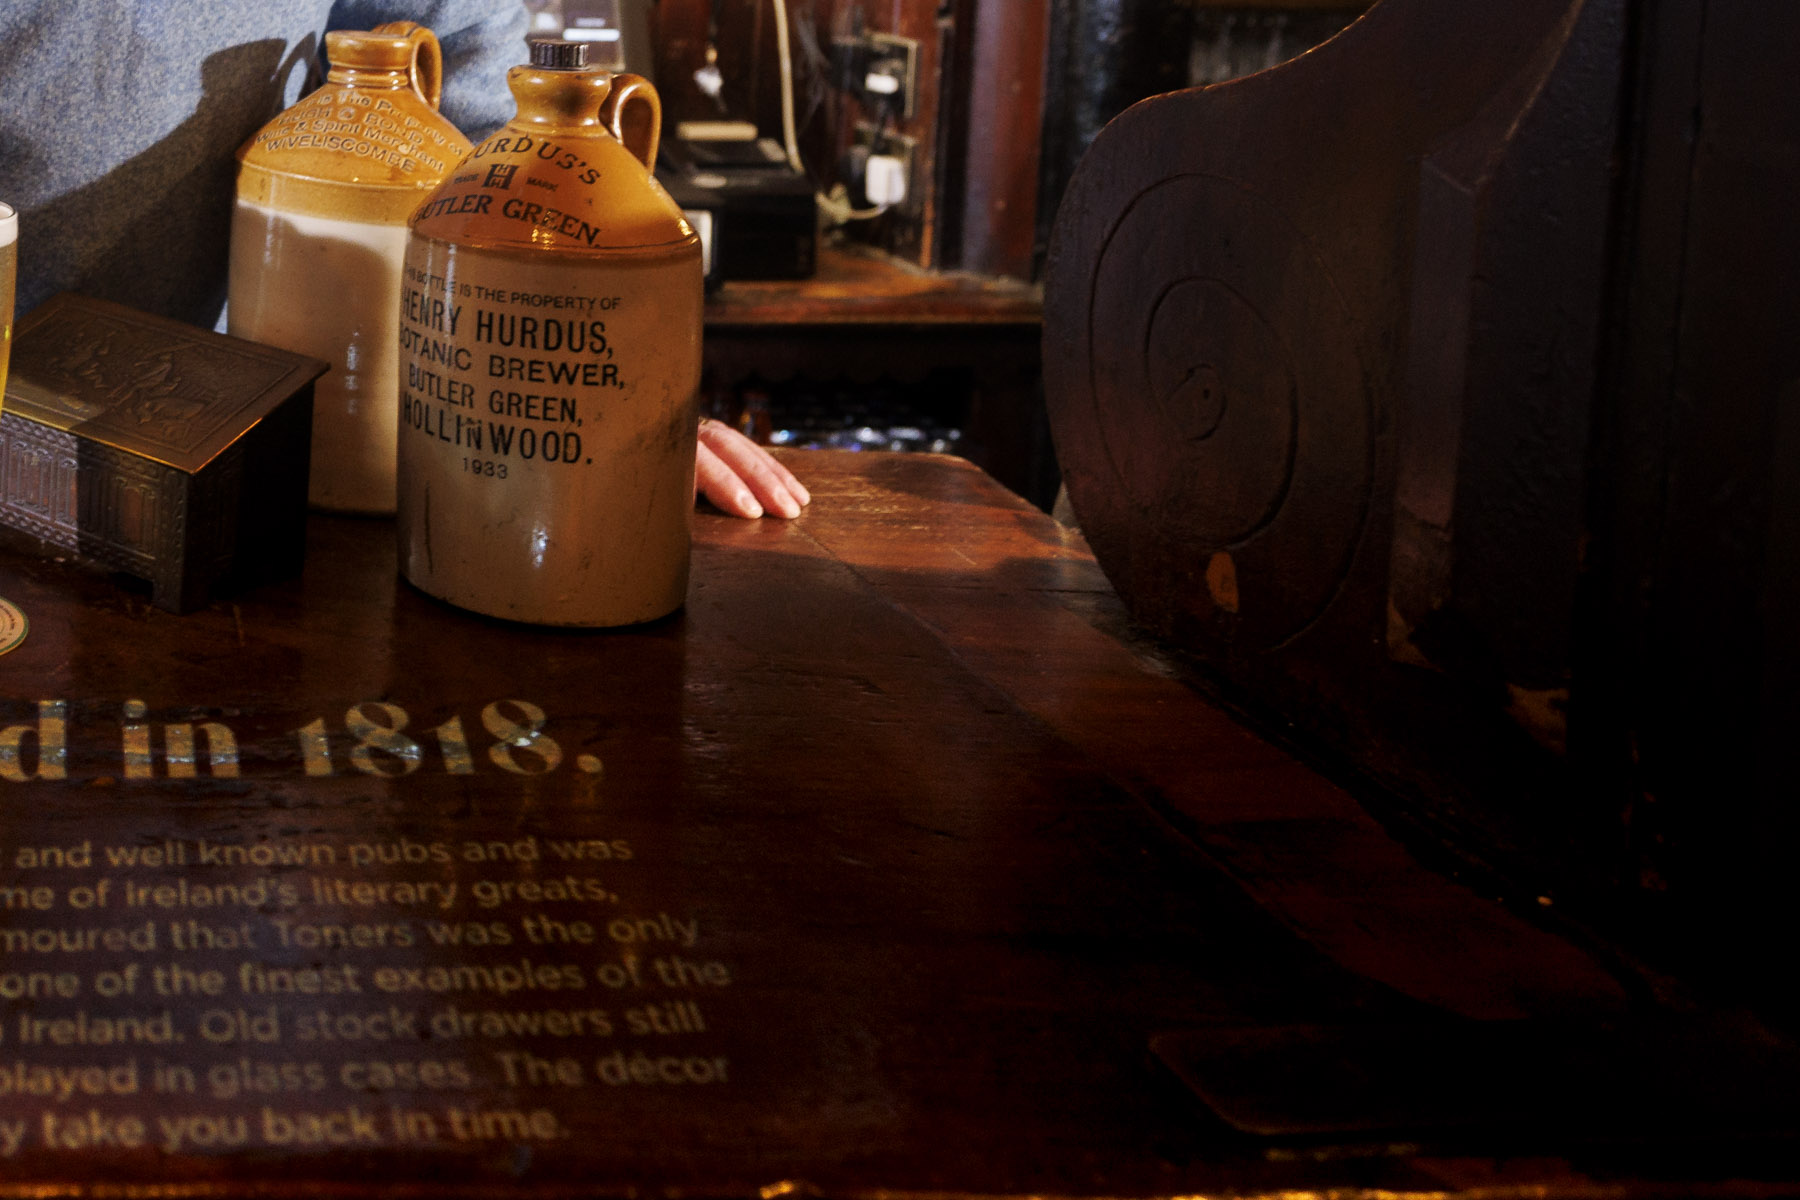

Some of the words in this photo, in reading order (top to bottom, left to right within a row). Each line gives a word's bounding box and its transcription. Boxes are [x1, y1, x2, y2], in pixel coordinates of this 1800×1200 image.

[337, 90, 371, 107] The
[311, 119, 360, 135] Spirit
[266, 133, 419, 174] WIVELISCOMBE
[460, 283, 471, 298] IS
[475, 285, 507, 304] THE
[511, 291, 597, 311] PROPERTY
[600, 297, 622, 311] OF
[403, 286, 462, 337] HENRY
[476, 310, 614, 360] HURDUS,
[488, 354, 626, 390] BREWER,
[409, 362, 475, 409] BUTLER
[488, 389, 583, 427] GREEN,
[462, 456, 509, 480] 1933
[123, 699, 240, 780] in
[295, 698, 602, 778] 1818.
[16, 842, 92, 868] and
[106, 842, 186, 867] well
[200, 840, 334, 867] known
[348, 839, 452, 871] pubs
[463, 836, 539, 863] and
[553, 839, 634, 860] was
[69, 878, 112, 909] of
[126, 877, 300, 908] Ireland's
[312, 876, 457, 909] literary
[170, 919, 256, 949] that
[271, 921, 412, 947] Toners
[427, 924, 513, 945] was
[522, 914, 594, 943] the
[609, 912, 698, 947] only
[0, 973, 79, 997] one
[95, 965, 138, 995] of
[153, 964, 227, 995] the
[240, 962, 362, 994] finest
[374, 959, 585, 994] examples
[599, 956, 642, 987] of
[656, 957, 732, 987] the
[19, 1011, 184, 1043] Ireland.
[202, 1008, 281, 1042] Old
[298, 1007, 421, 1040] stock
[431, 1007, 611, 1037] drawers
[624, 1003, 706, 1033] still
[153, 1060, 194, 1093] in
[207, 1060, 326, 1097] glass
[498, 1053, 582, 1086] The
[41, 1109, 145, 1147] take
[159, 1117, 246, 1153] you
[262, 1107, 374, 1144] back
[393, 1107, 436, 1140] in
